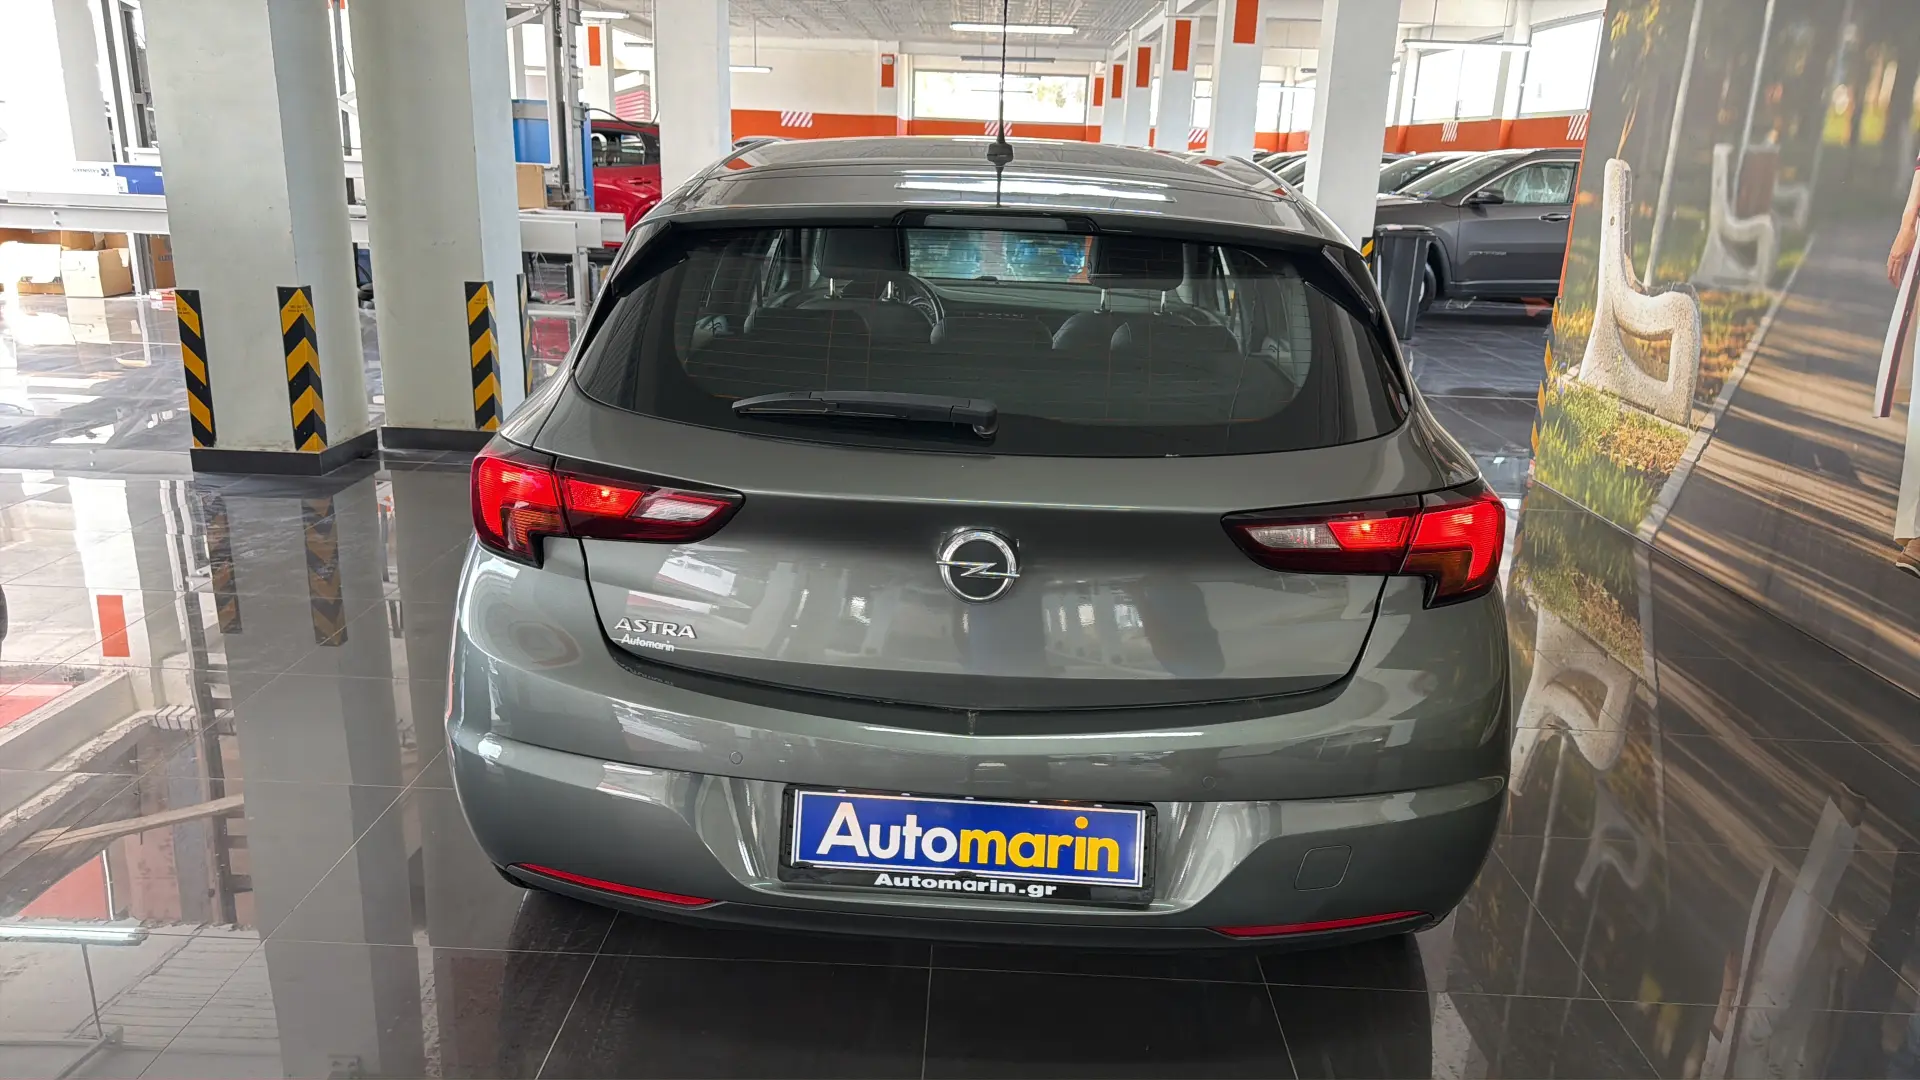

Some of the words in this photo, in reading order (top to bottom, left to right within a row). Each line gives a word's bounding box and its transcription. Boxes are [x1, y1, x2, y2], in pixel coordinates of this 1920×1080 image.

[614, 617, 697, 639] ASTRA
[621, 633, 675, 652] Automarin
[816, 802, 1119, 872] Automarin
[874, 873, 1057, 898] Automarin.gr
